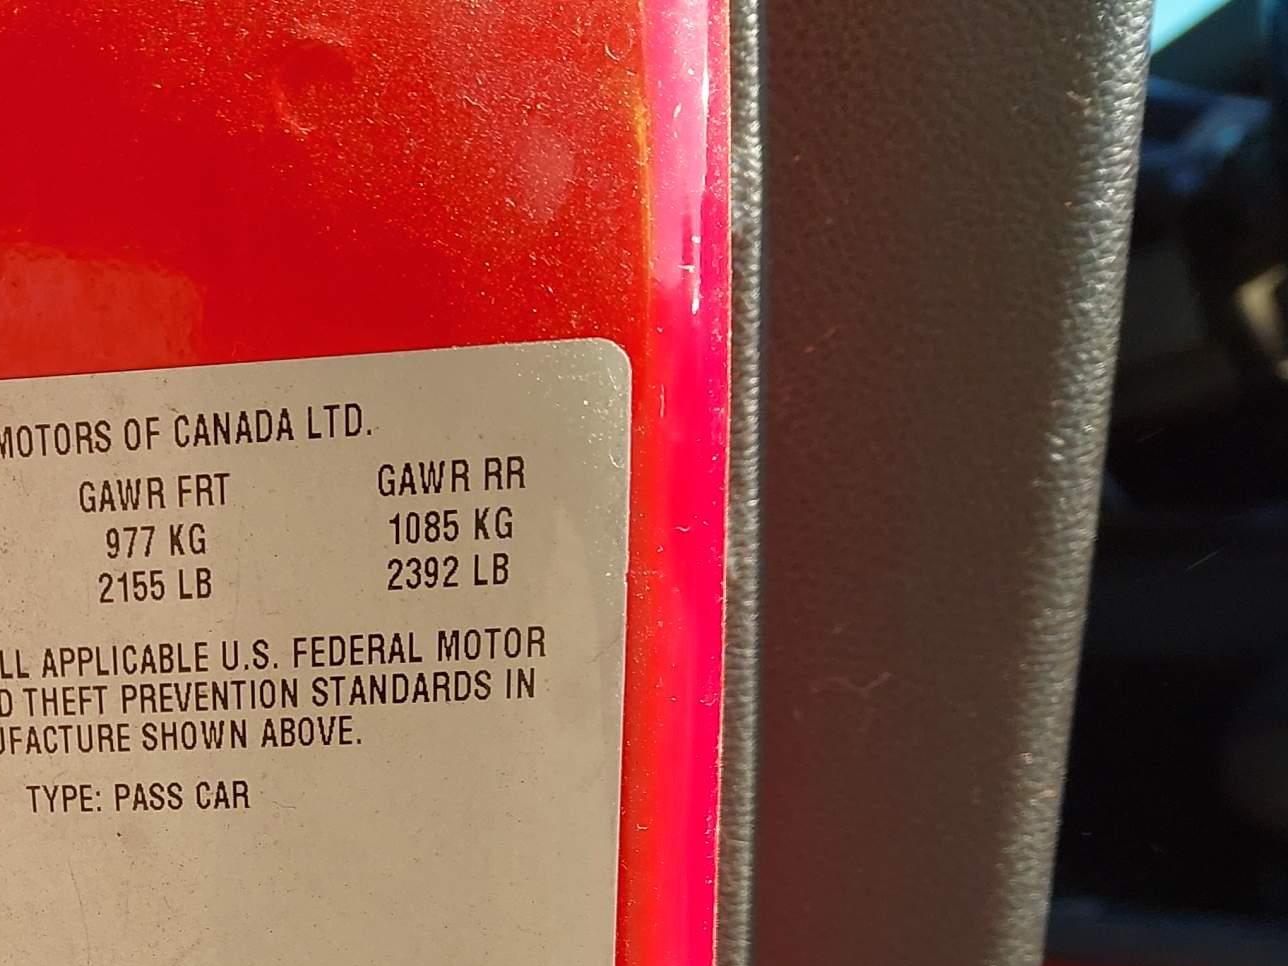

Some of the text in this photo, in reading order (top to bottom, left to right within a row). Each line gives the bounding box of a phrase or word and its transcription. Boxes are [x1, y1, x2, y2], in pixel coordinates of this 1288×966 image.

[124, 417, 159, 450] OF
[172, 408, 294, 447] CANADA
[308, 403, 371, 439] LTD.
[80, 473, 230, 513] GAWR FRT
[378, 456, 525, 496] GAWR RR
[106, 523, 206, 559] 977 KG
[389, 507, 512, 544] 1085 KG
[99, 568, 211, 603] 2155 LB
[388, 553, 508, 590] 2392 LB
[42, 642, 208, 678] APPLICABLE
[222, 639, 277, 670] U.S.
[294, 632, 422, 668] FEDERAL
[438, 626, 546, 661] MOTOR
[23, 686, 107, 716] THEFT
[122, 678, 297, 714] PREVENTION
[312, 670, 491, 706] STANDARDS
[507, 668, 534, 699] IN
[142, 719, 247, 751] SHOWN
[261, 716, 361, 747] ABOVE.
[26, 781, 250, 813] TYPE: PASS CAR
